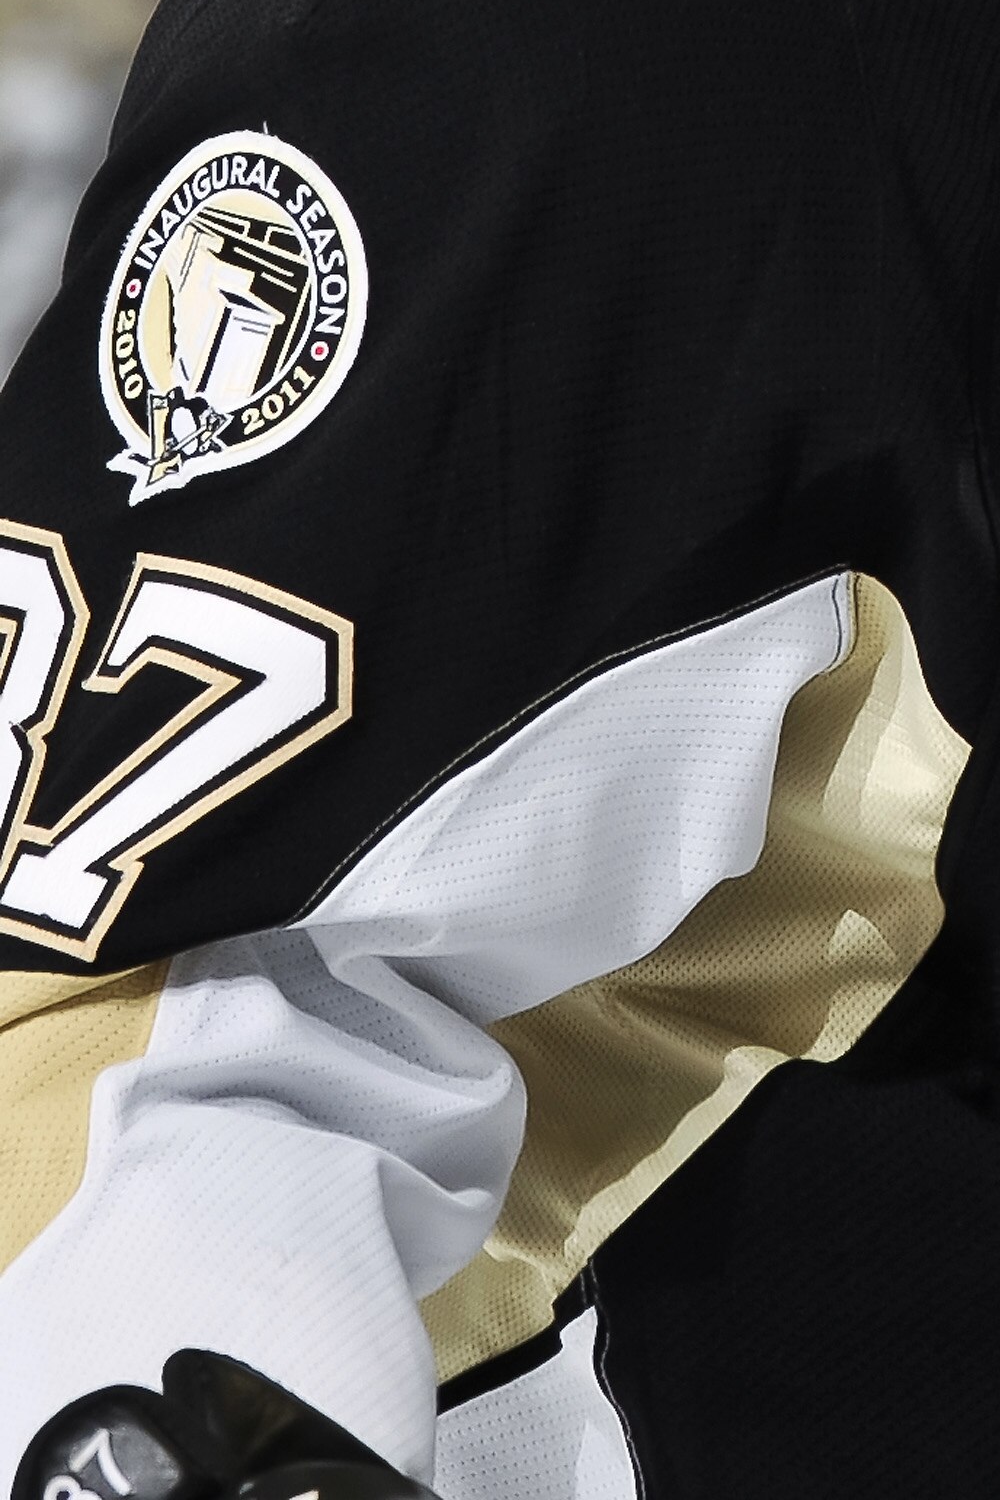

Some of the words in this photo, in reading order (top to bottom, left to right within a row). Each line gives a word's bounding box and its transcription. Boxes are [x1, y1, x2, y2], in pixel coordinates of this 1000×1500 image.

[135, 155, 280, 270] INAUGURAL
[286, 184, 348, 336] SEASON
[115, 309, 143, 399] 2010
[241, 366, 315, 435] 2011
